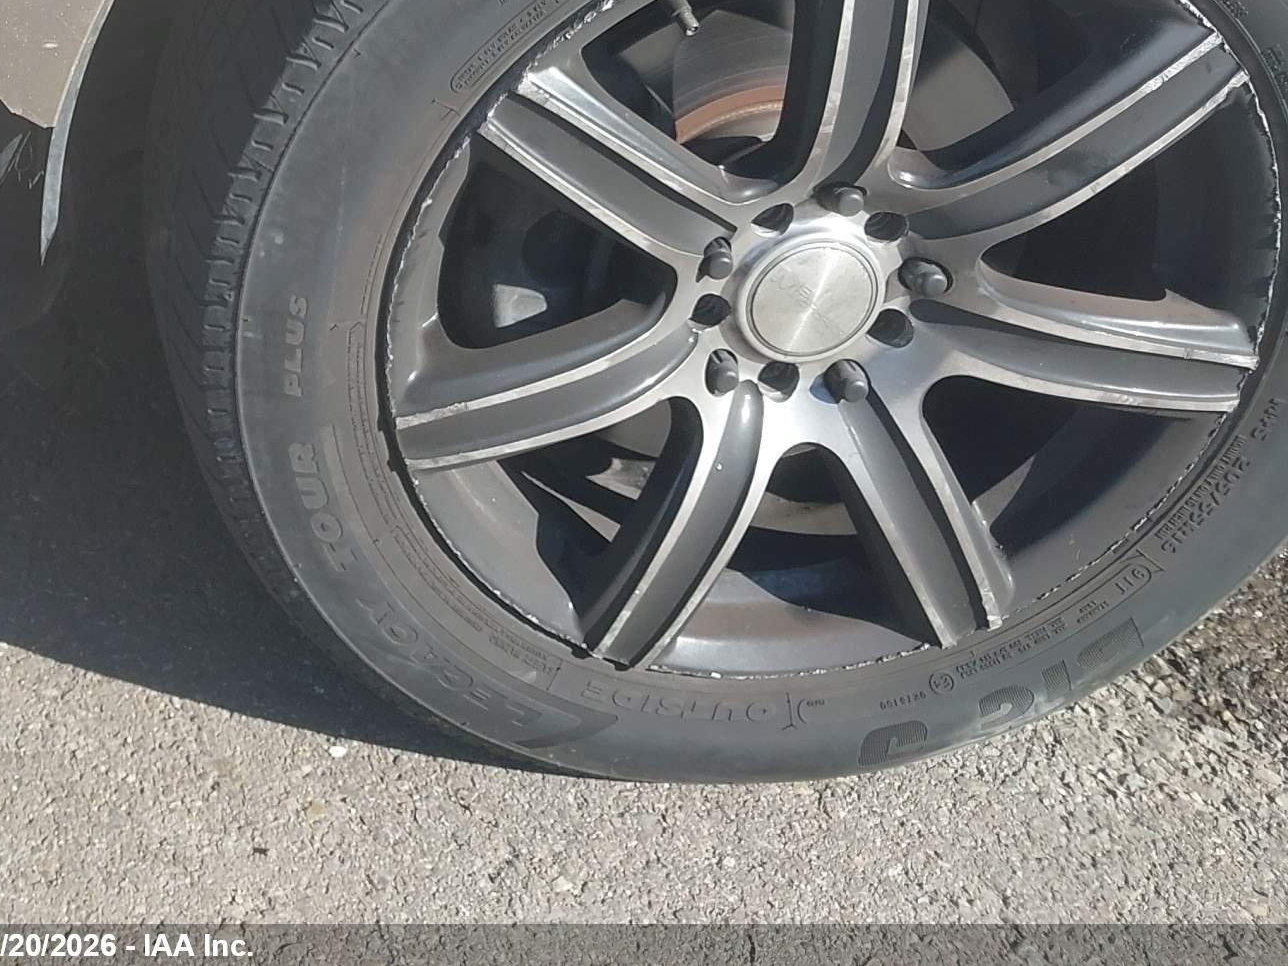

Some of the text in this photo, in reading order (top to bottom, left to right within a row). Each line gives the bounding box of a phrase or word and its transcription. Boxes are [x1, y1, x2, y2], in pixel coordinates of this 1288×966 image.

[284, 295, 308, 397] PLUS
[287, 442, 359, 572] TOUR
[1160, 455, 1252, 555] 205/55R16
[355, 599, 543, 729] LEGACY
[581, 682, 768, 722] OUTSIDE
